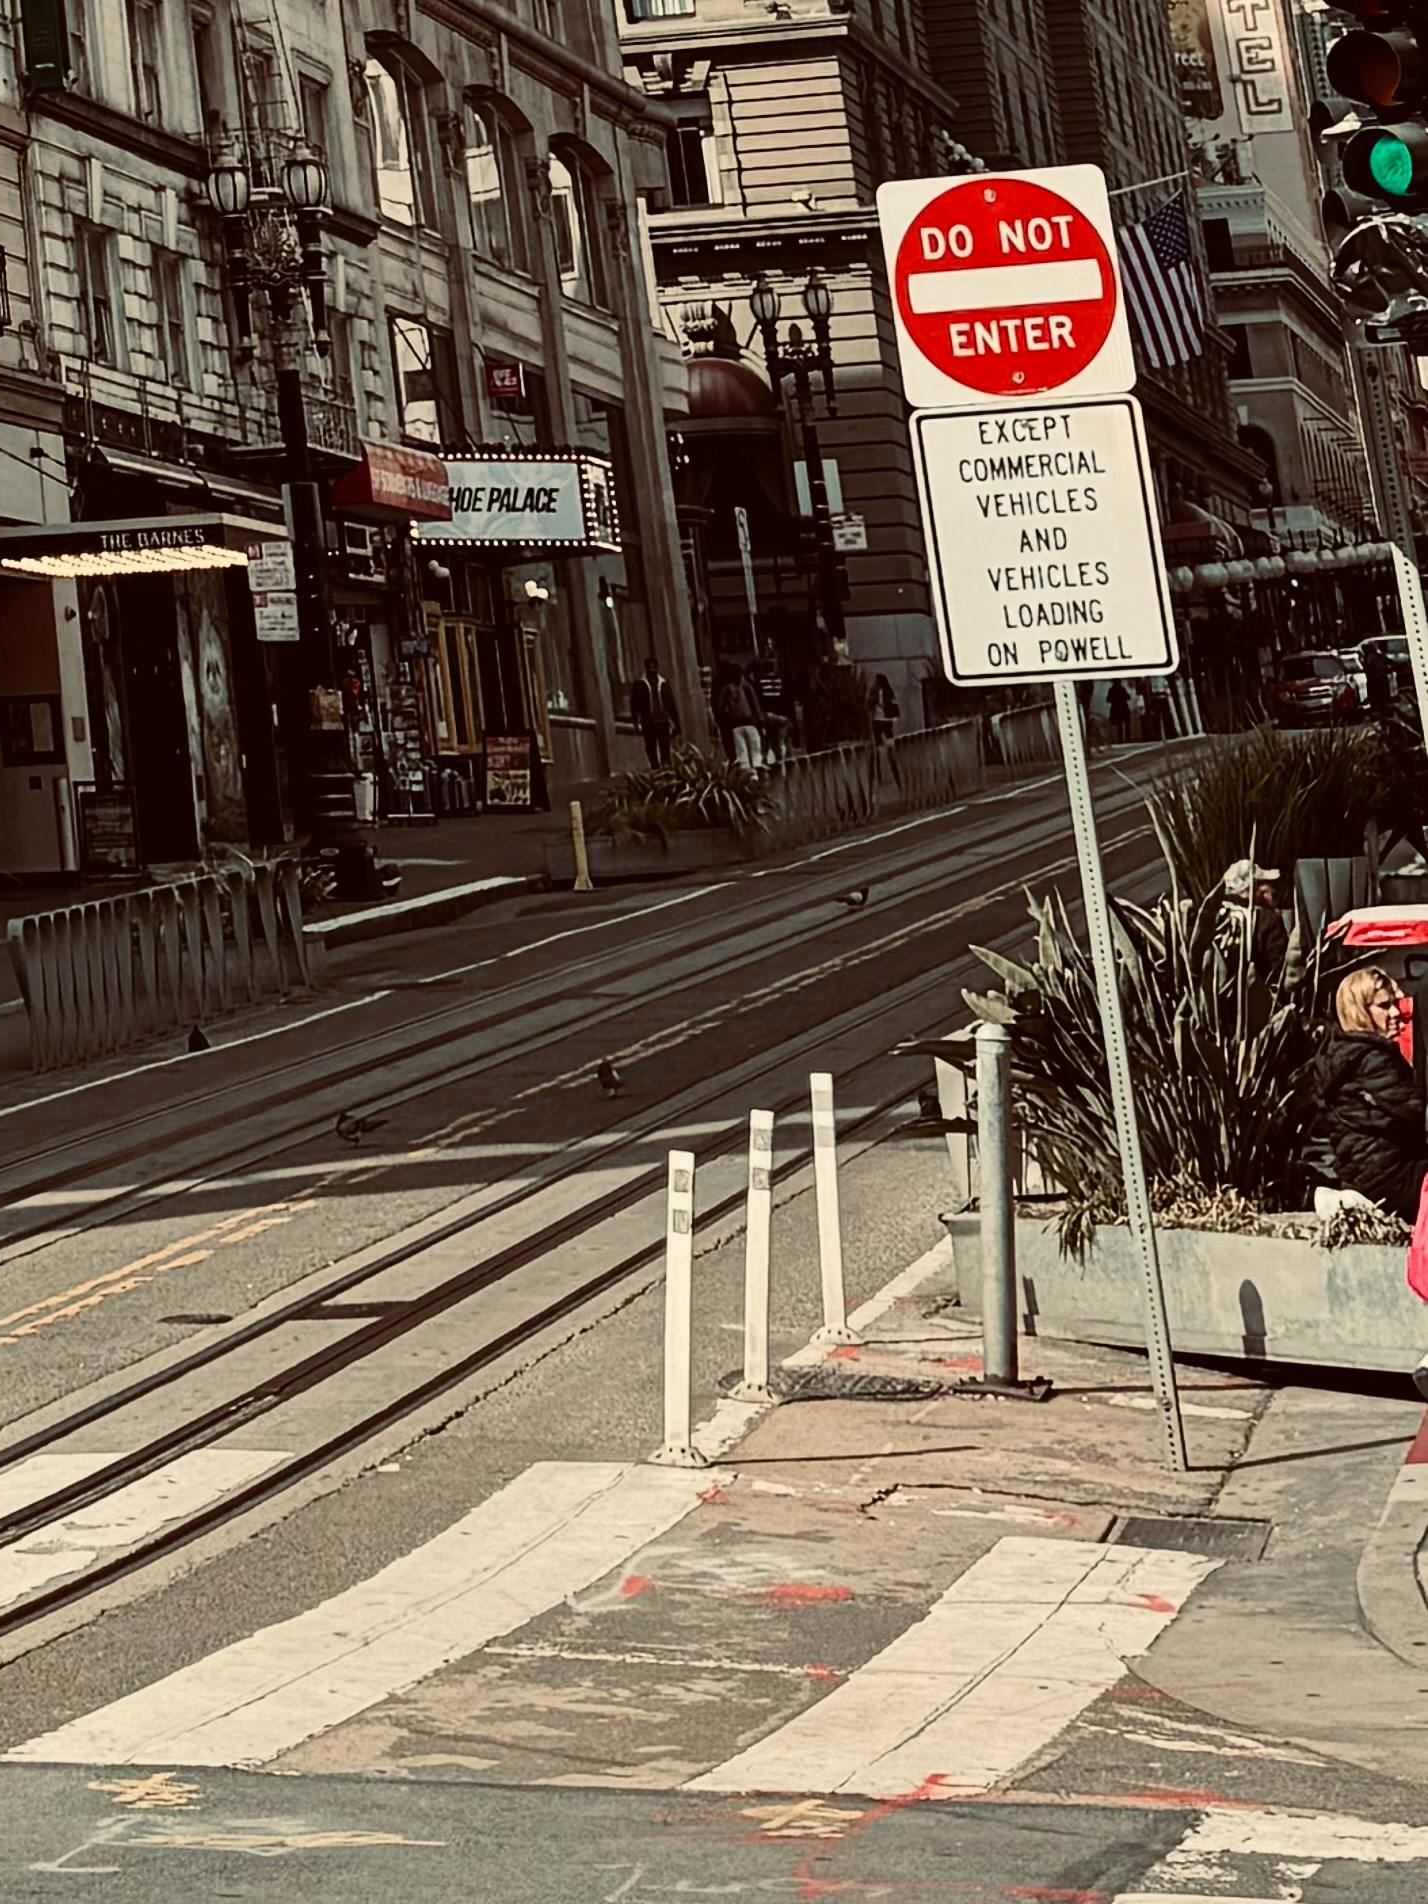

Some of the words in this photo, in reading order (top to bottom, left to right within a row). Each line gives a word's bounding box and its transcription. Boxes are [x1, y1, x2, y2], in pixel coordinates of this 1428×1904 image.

[919, 223, 974, 261] DO
[997, 214, 1074, 254] NOT
[948, 314, 1077, 358] ENTER
[978, 414, 1071, 445] EXCEPT
[958, 449, 1107, 483] COMMERCIAL
[448, 487, 486, 513] HOE
[487, 487, 560, 513] PALACE
[976, 487, 1099, 519] VEHICLES
[100, 533, 133, 550] THE
[136, 528, 206, 549] BARNES
[1019, 526, 1068, 554] AND
[987, 561, 1110, 592] VEHICLES
[1003, 598, 1104, 629] LOADING
[987, 642, 1020, 667] ON
[1038, 635, 1133, 665] POWELL
